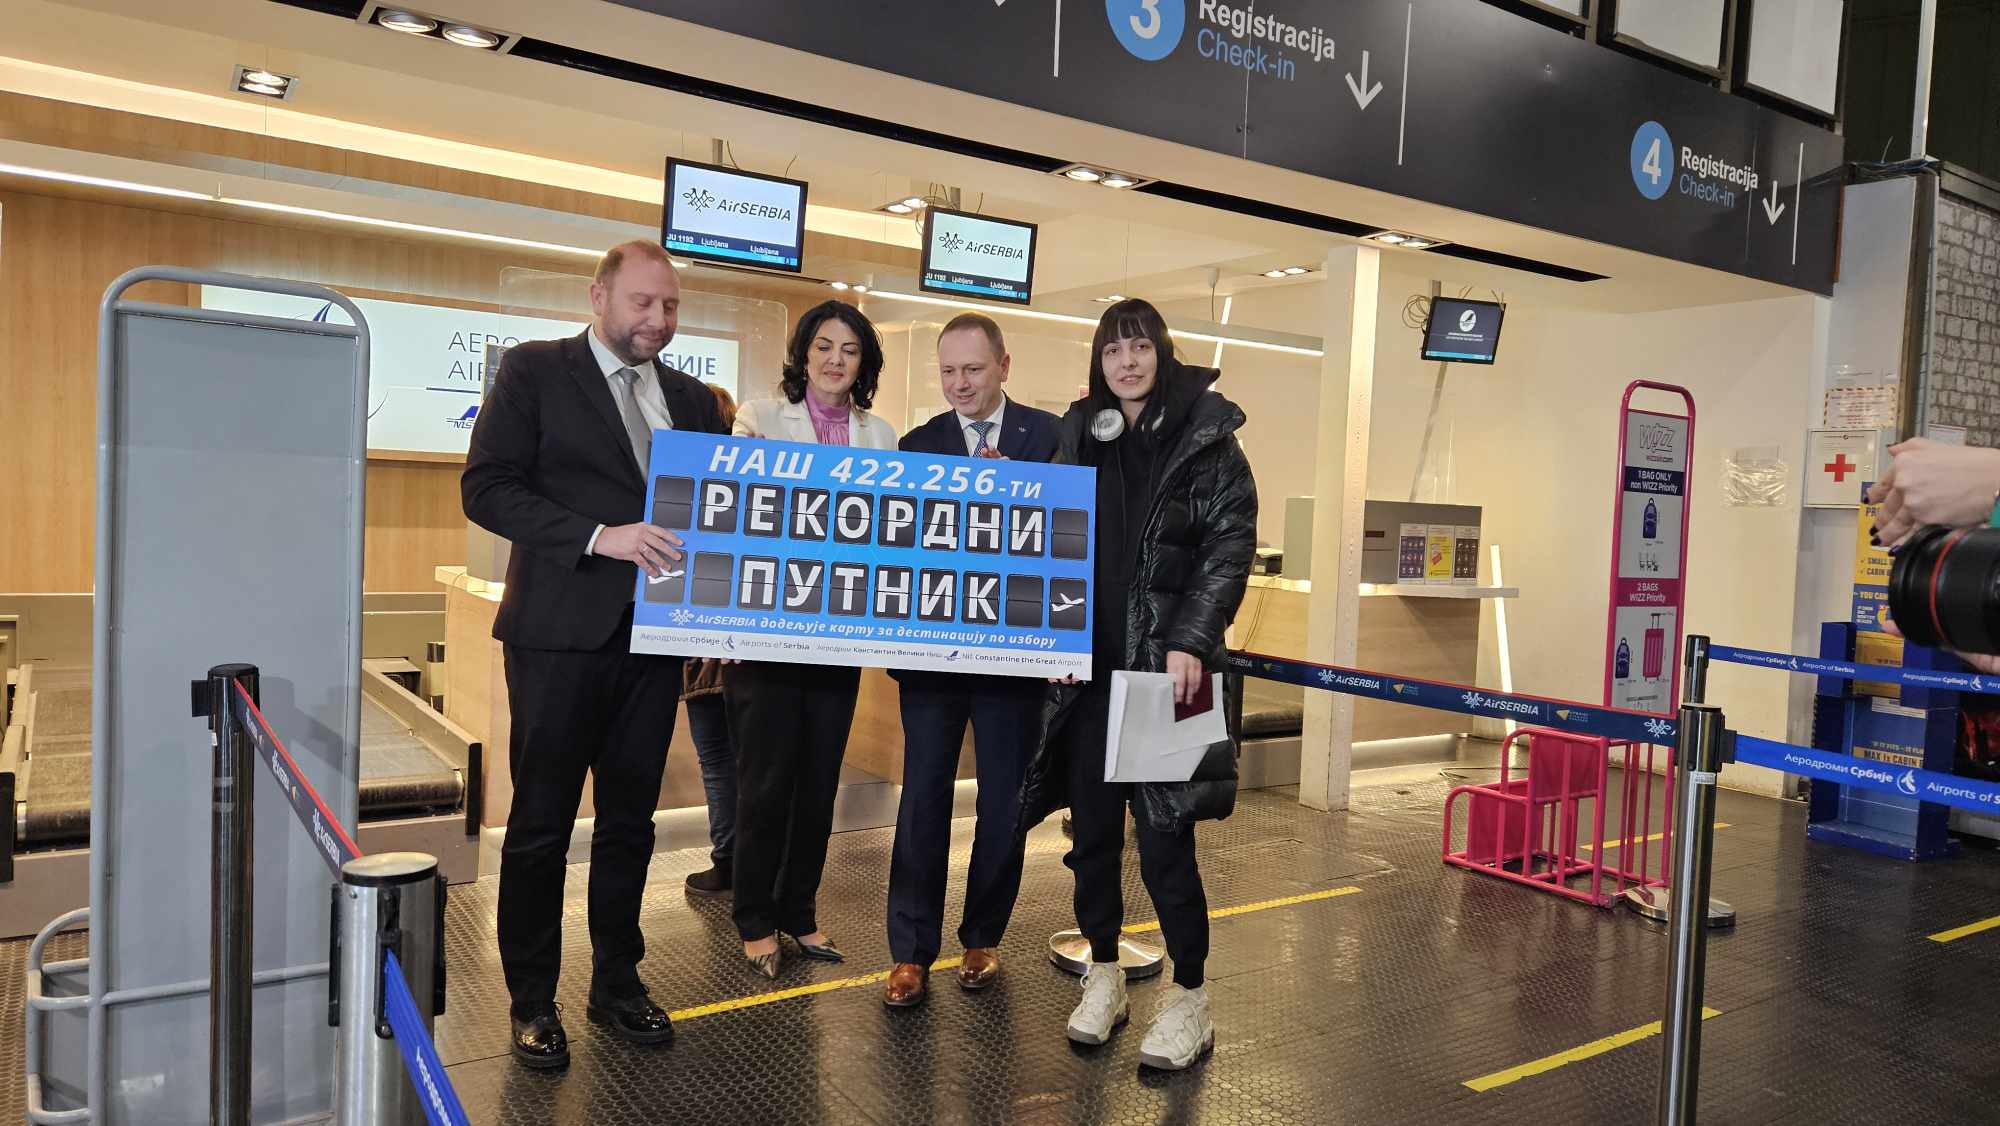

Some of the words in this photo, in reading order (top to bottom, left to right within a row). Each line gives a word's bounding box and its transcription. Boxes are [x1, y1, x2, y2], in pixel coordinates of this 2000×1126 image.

[1199, 0, 1336, 61] Registracija
[1198, 28, 1295, 81] Check-in
[1641, 138, 1662, 185] 4
[1681, 146, 1759, 191] Registracija
[1680, 174, 1735, 208] Check-in
[717, 199, 791, 221] AirSERBIA
[965, 241, 1023, 259] AirSERBIA
[708, 443, 815, 481] НАШ
[703, 484, 1044, 553] РЕКОРДНИ
[741, 560, 999, 622] ПУТНИК
[760, 617, 825, 635] додељује
[829, 623, 873, 638] карту
[877, 627, 893, 637] за
[896, 626, 986, 644] дестинацију
[989, 632, 1005, 645] по
[1009, 634, 1056, 650] избору
[783, 641, 811, 651] Serbia
[975, 654, 1020, 665] Constantine
[1022, 656, 1034, 665] the
[1036, 657, 1056, 666] Great
[1335, 676, 1380, 690] AirSERBIA
[1484, 699, 1539, 716] AirSERBIA
[1784, 753, 1848, 774] Аеродроми
[1850, 766, 1893, 783] Србије
[1927, 781, 1976, 800] Airports
[1979, 793, 1993, 803] of
